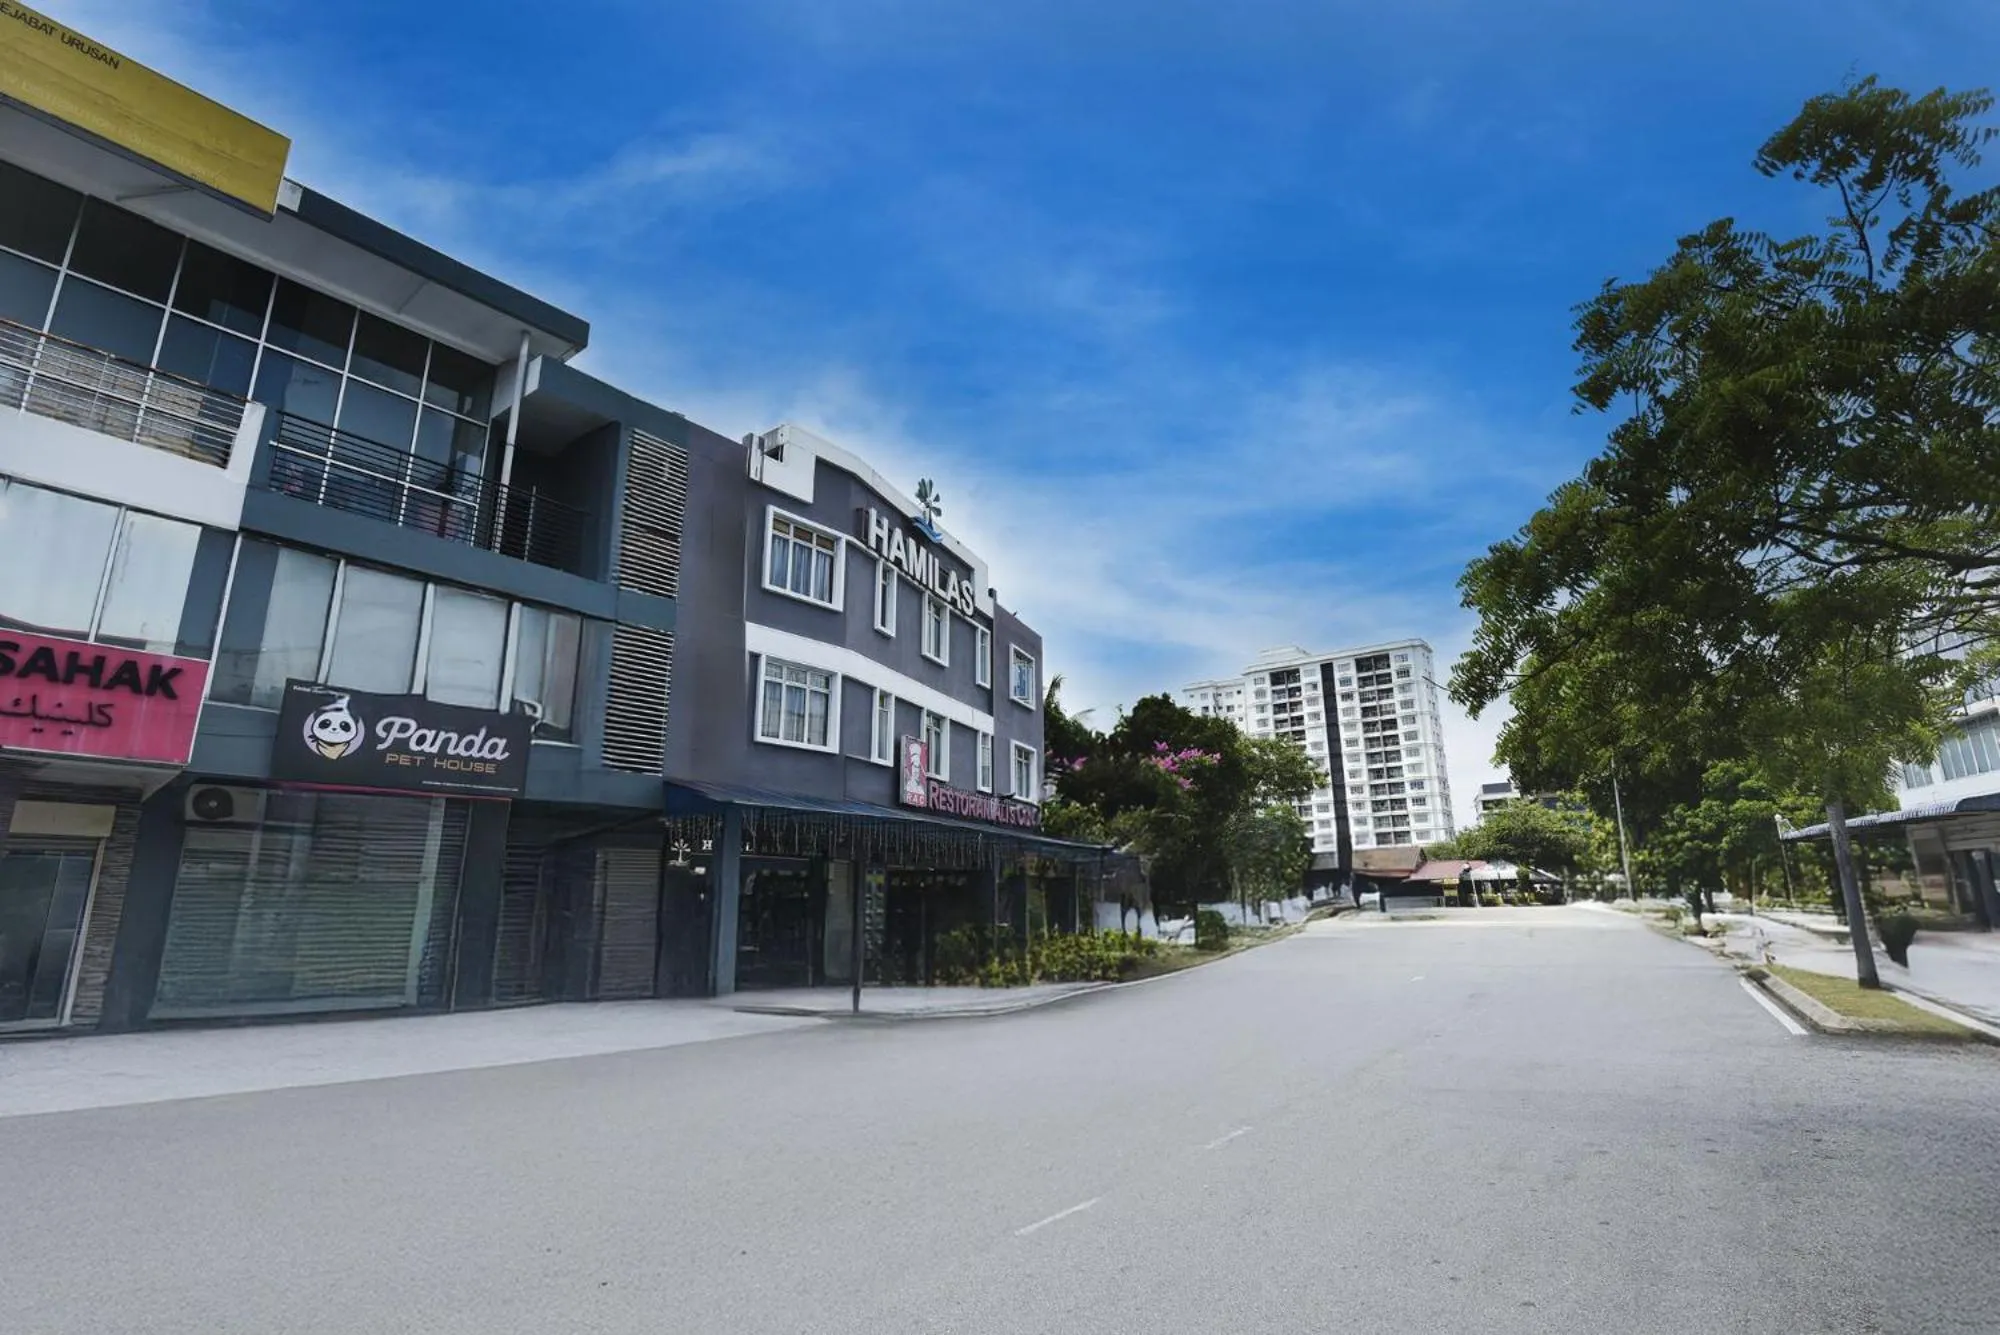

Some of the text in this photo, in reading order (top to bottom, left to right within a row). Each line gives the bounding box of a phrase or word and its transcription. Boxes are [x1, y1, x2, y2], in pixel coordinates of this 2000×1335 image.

[60, 31, 120, 70] URUSAN
[867, 506, 975, 616] HAMILAS
[0, 640, 182, 700] SAHAK
[375, 716, 511, 760] Panda
[385, 753, 497, 774] PET HOUSE
[929, 781, 991, 820] RESTORAN
